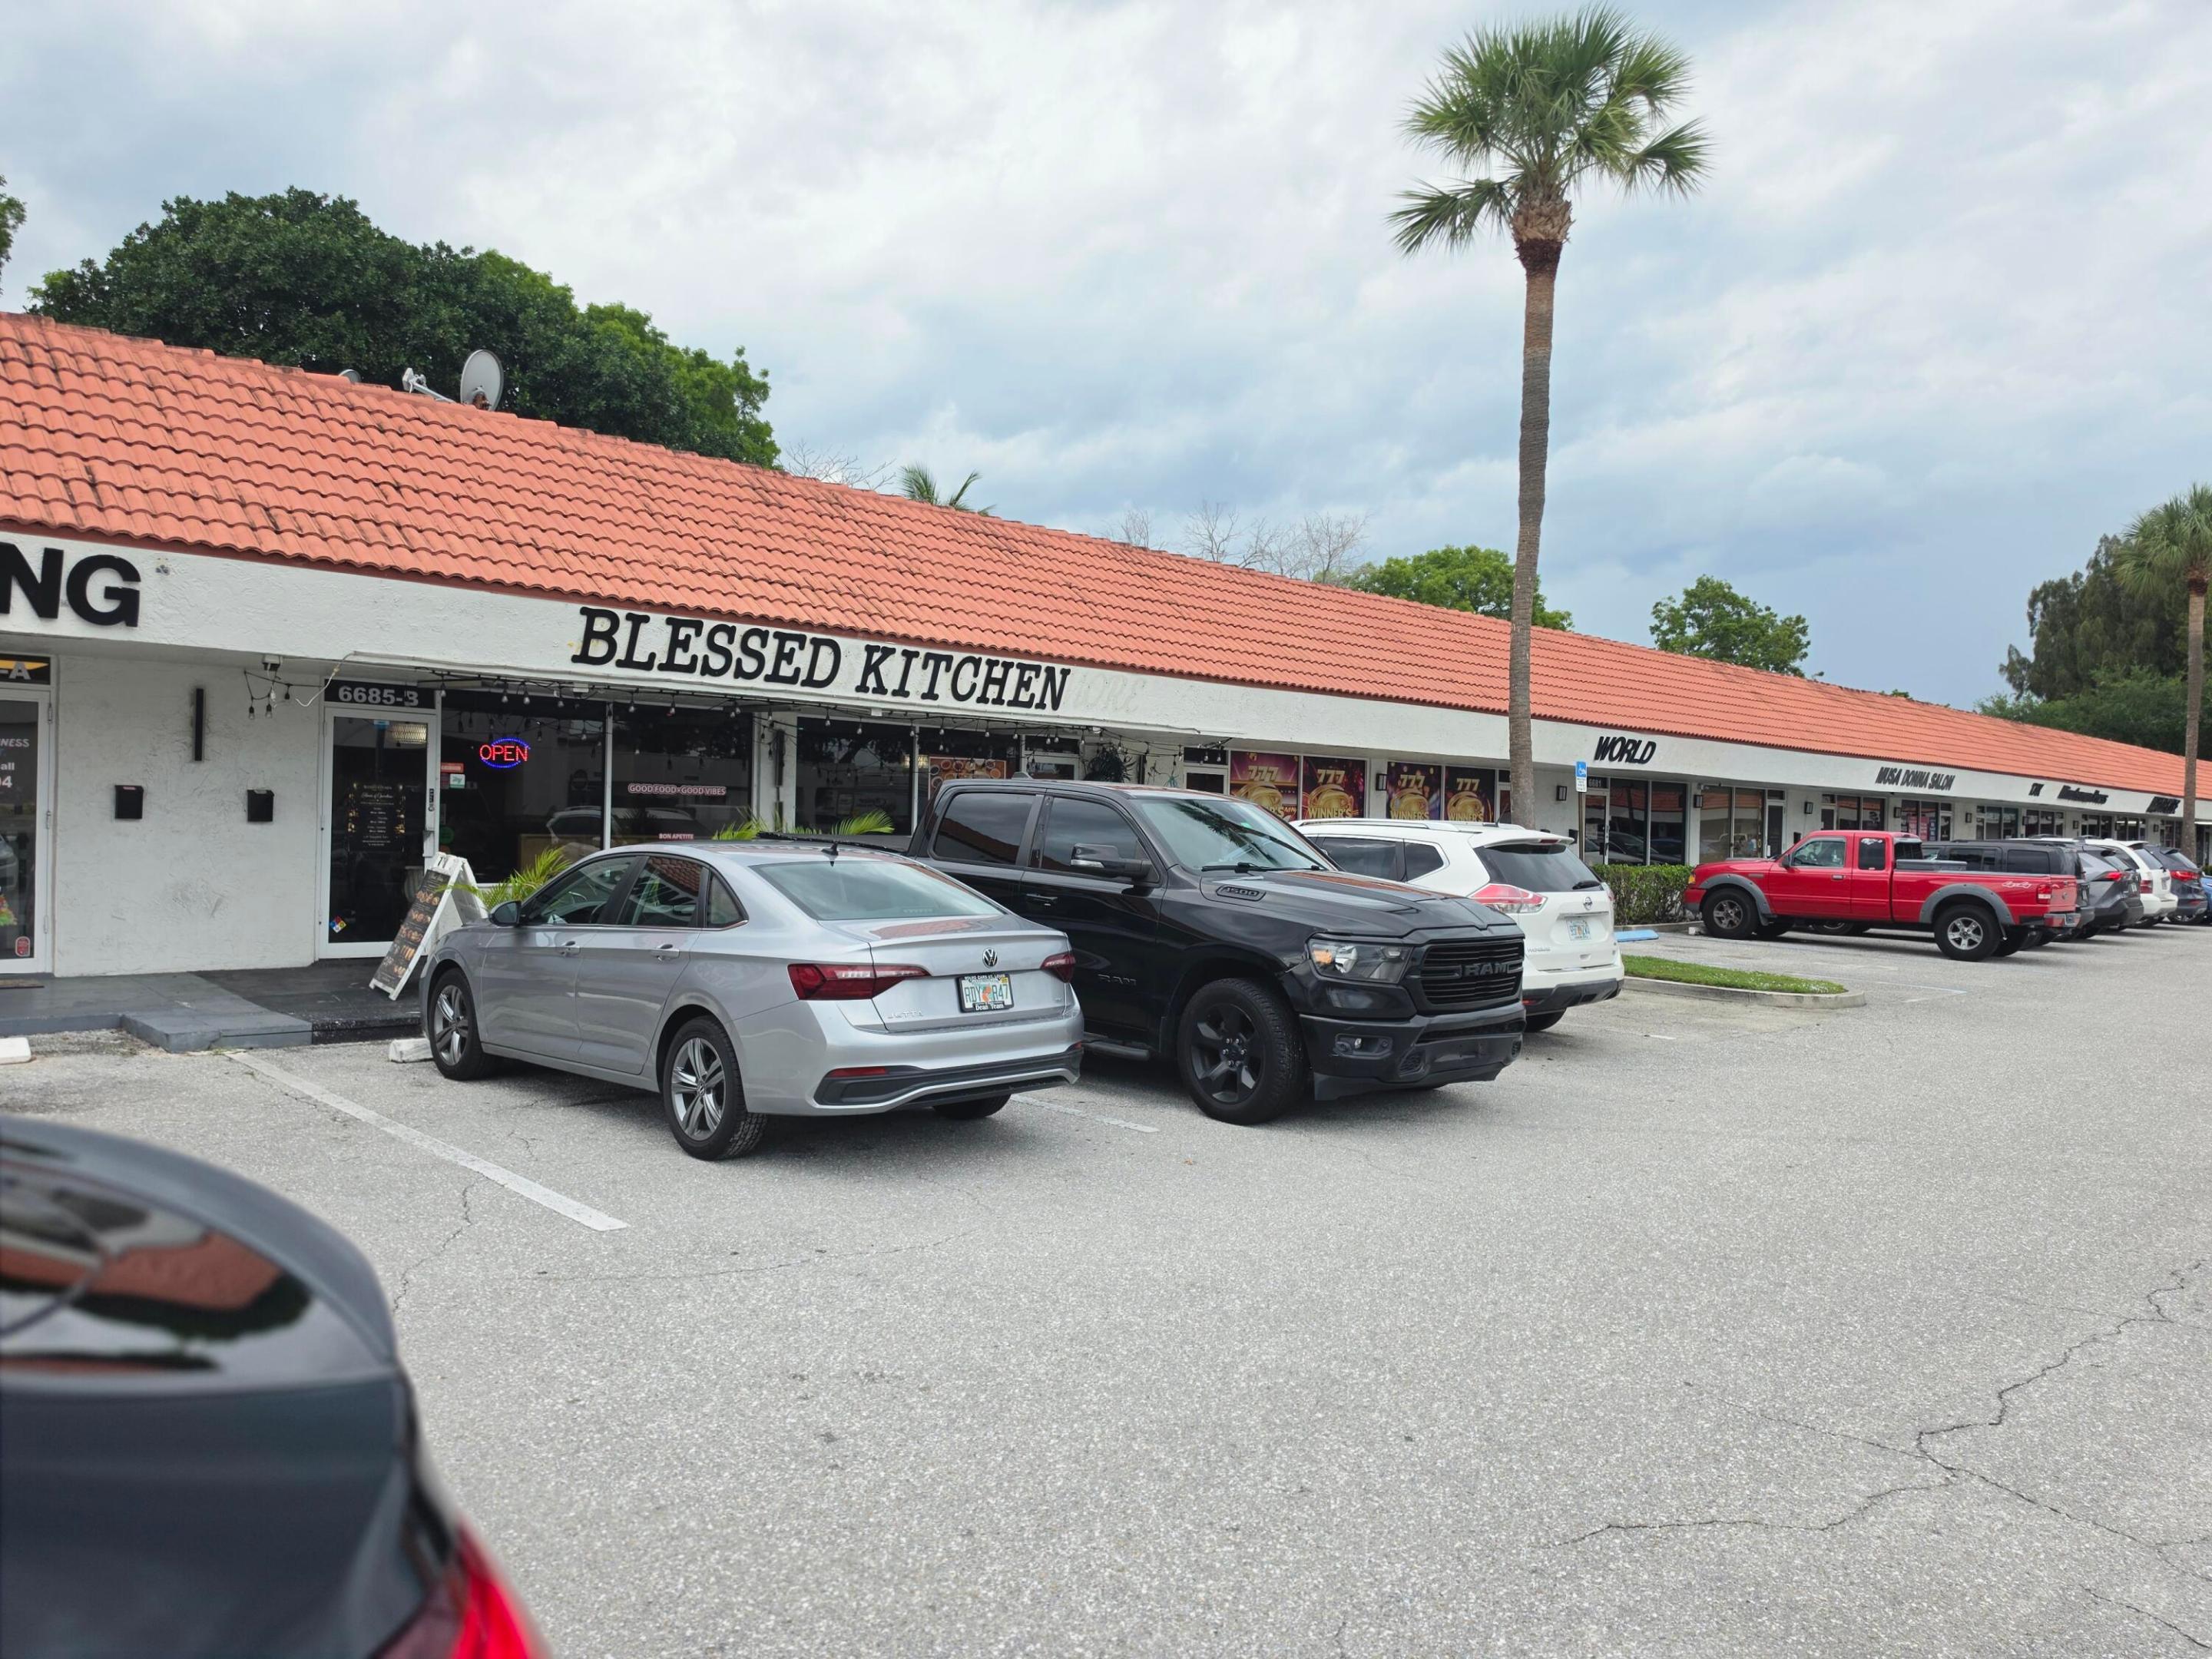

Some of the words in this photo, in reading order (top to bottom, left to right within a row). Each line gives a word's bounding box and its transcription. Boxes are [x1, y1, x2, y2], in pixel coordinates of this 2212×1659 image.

[571, 607, 842, 688] BLESSED
[854, 644, 1071, 711] KITCHEN
[338, 686, 419, 707] 6685-3
[479, 744, 528, 762] OPEN
[1594, 737, 1657, 764] WORLD
[1248, 766, 1279, 782] 777
[1317, 769, 1345, 784] 777
[1400, 774, 1425, 787] 777
[1456, 778, 1480, 791] 777
[1928, 773, 1955, 791] SALON
[629, 784, 653, 793] GOOD
[654, 786, 677, 794] FOOD
[680, 786, 704, 795] GOOD
[705, 787, 726, 796] VIBES
[1307, 807, 1353, 819] WINNER'S
[1390, 810, 1429, 820] WINNER'S
[1462, 962, 1507, 976] RAM
